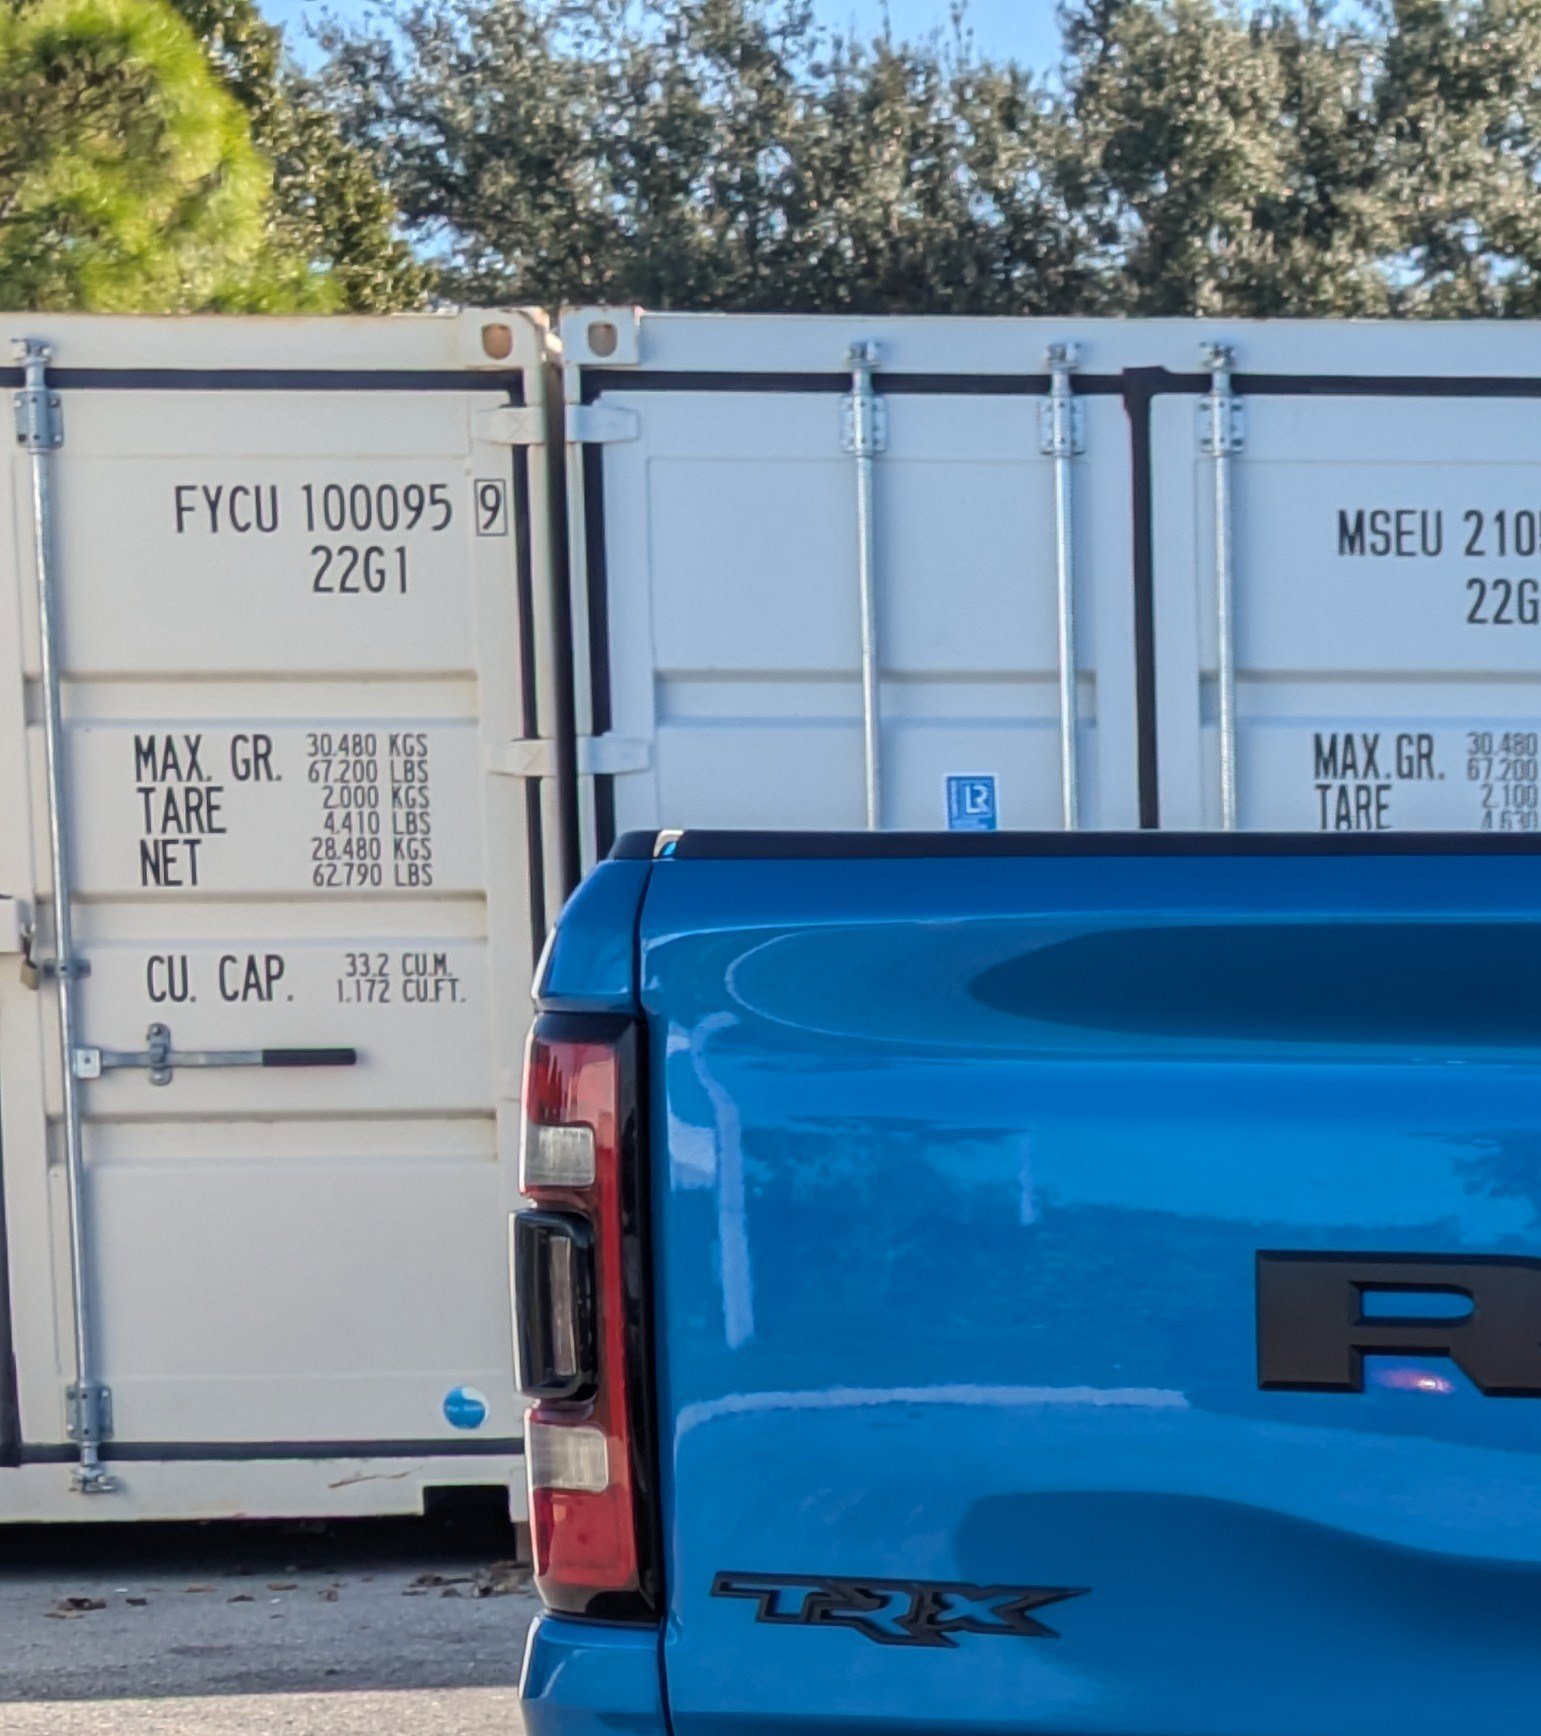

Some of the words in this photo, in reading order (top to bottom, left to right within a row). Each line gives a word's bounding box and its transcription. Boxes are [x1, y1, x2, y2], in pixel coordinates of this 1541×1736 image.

[174, 484, 279, 533] FYCU
[302, 483, 453, 532] 100095
[479, 484, 501, 530] 9
[1337, 508, 1443, 557] MSEU
[311, 545, 407, 594] 22G1
[134, 734, 212, 783] MAX.
[230, 734, 282, 782] GR.
[306, 733, 377, 757] 30.480
[389, 733, 428, 757] KGS
[307, 759, 378, 783] 67.200
[391, 759, 429, 783] LBS
[137, 786, 227, 834] TARE
[391, 785, 430, 809] KGS
[1314, 783, 1393, 830] TARE
[392, 811, 431, 835] LBS
[139, 838, 201, 887] NET
[311, 837, 381, 861] 28.480
[393, 837, 432, 861] KGS
[394, 862, 433, 887] LBS
[147, 954, 197, 1003] CU.
[219, 953, 294, 1002] CAP.
[710, 1570, 1092, 1649] TRX
